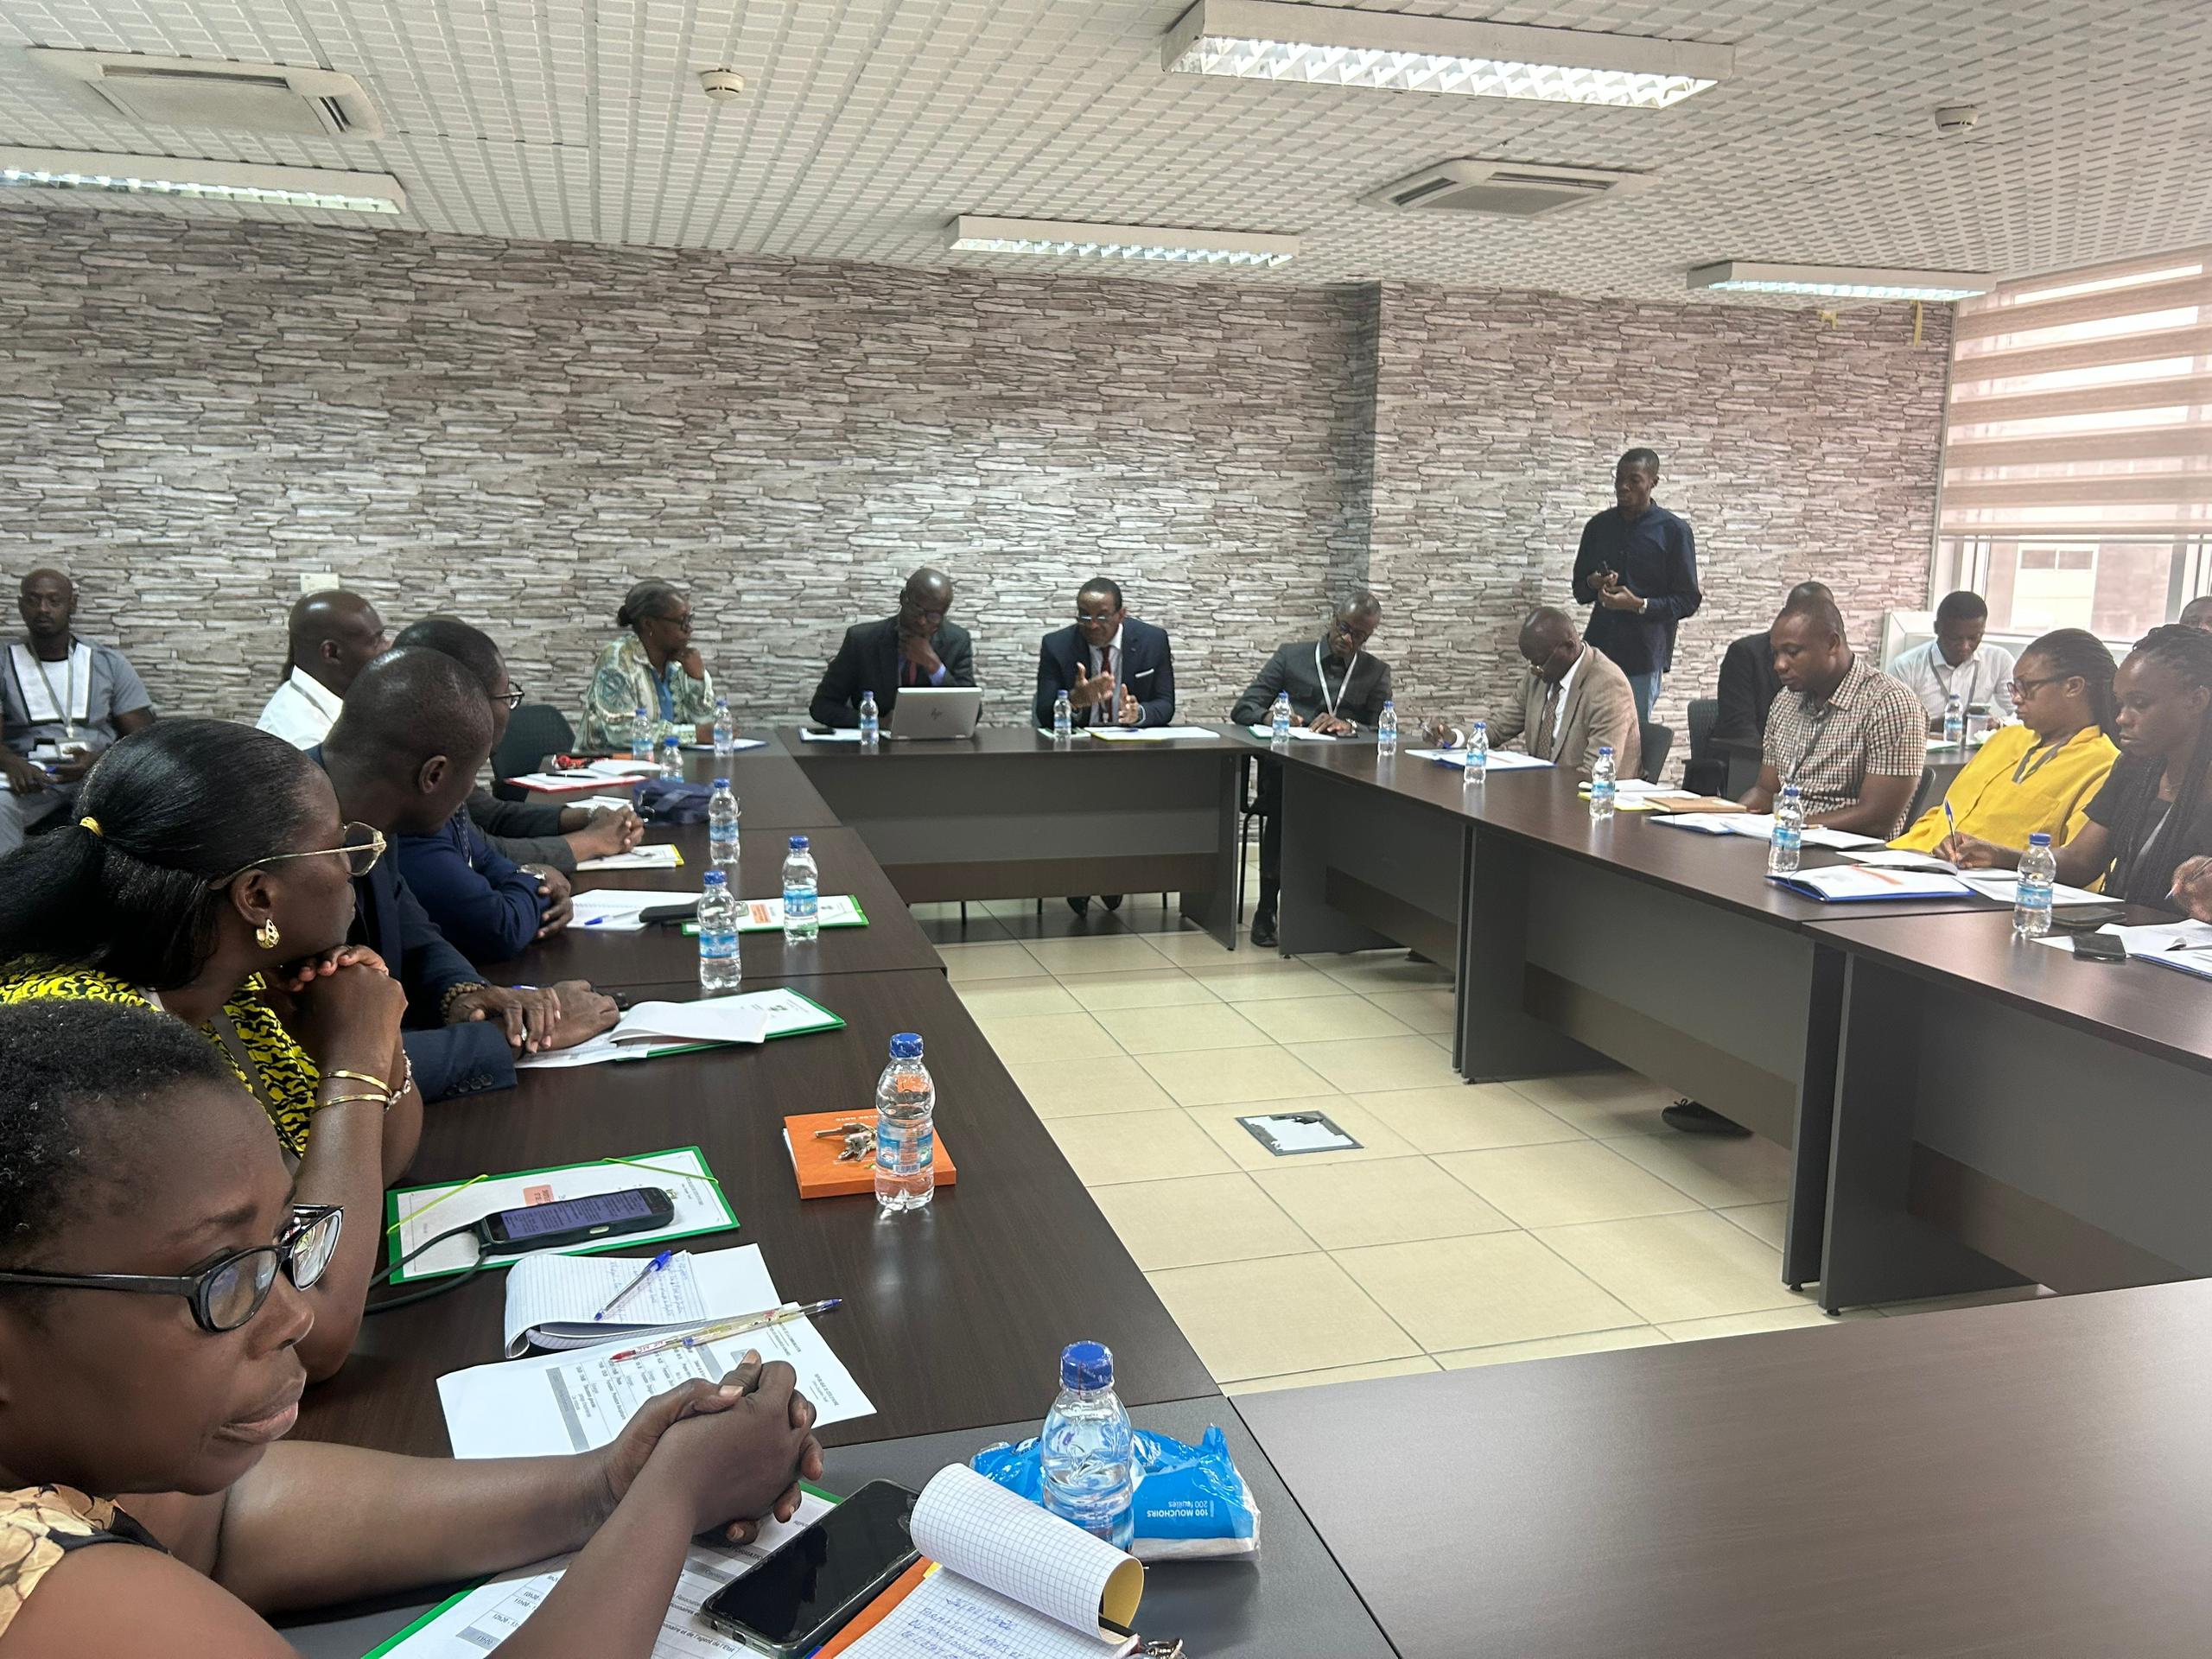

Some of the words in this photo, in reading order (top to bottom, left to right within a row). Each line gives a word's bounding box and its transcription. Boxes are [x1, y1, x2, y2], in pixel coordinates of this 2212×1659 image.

[1167, 1500, 1193, 1509] feuilles
[1194, 1500, 1208, 1509] 200
[1147, 1509, 1193, 1518] MOUCHOIRS
[1194, 1509, 1209, 1517] 100
